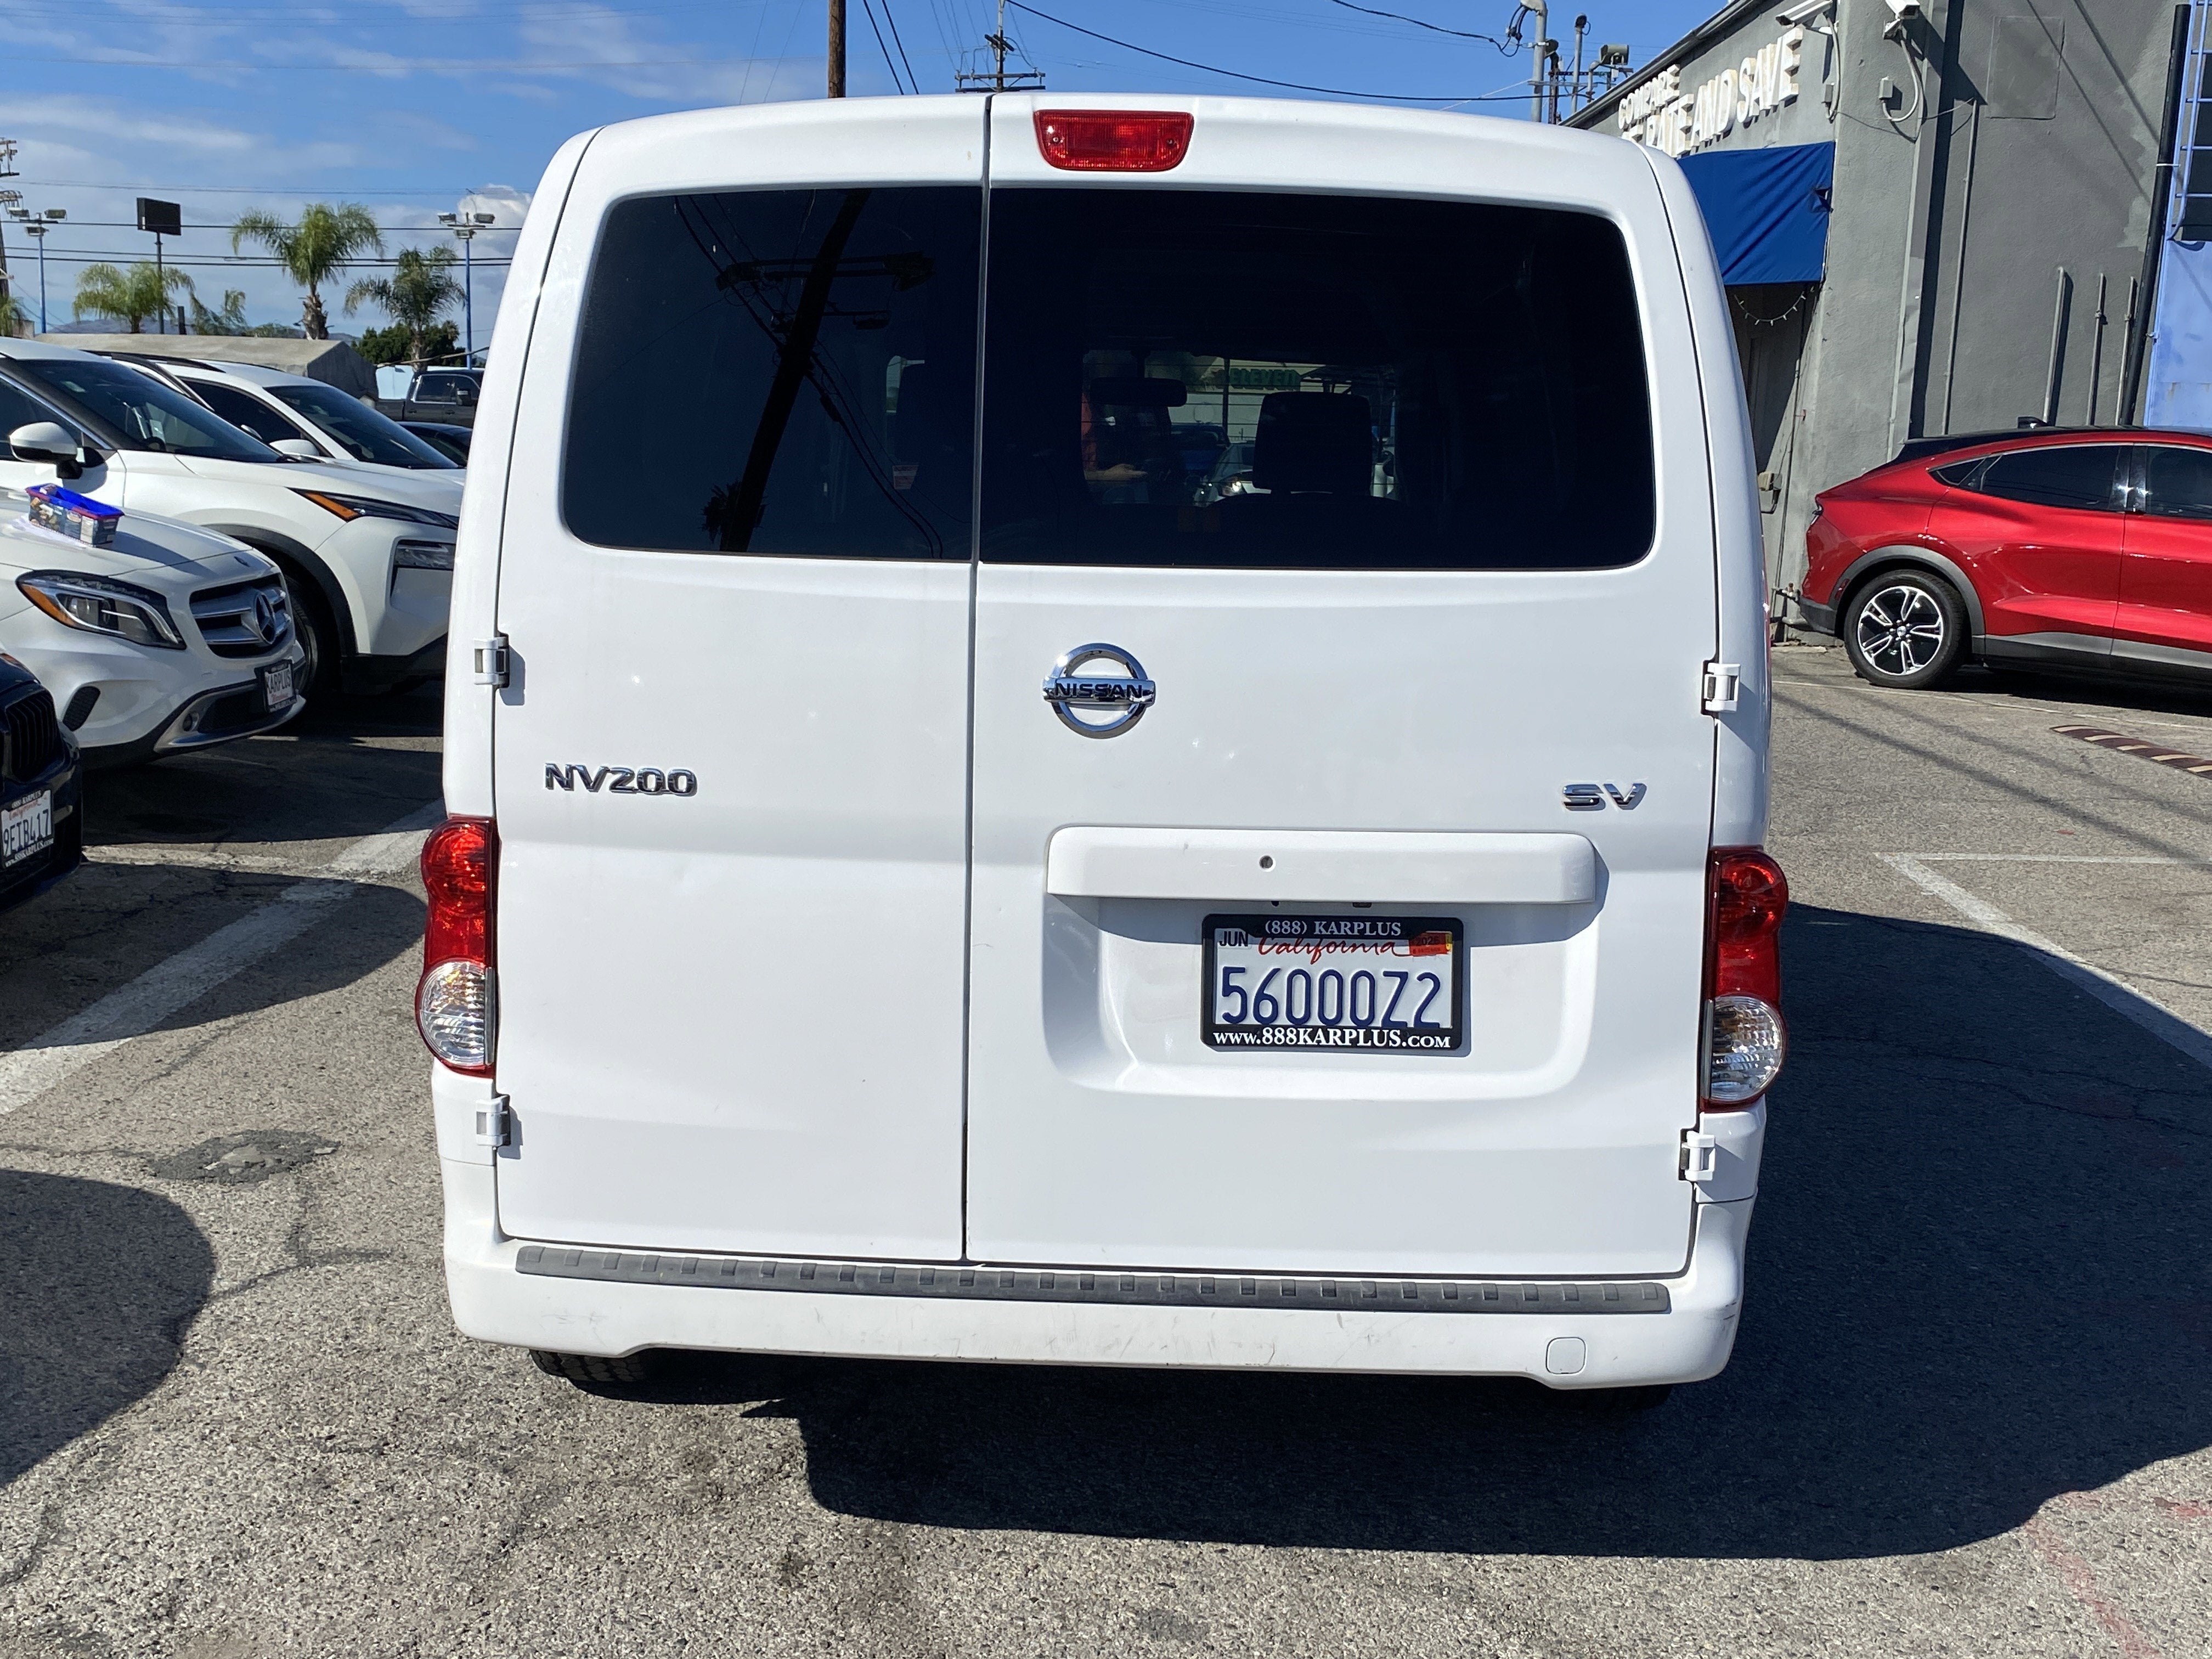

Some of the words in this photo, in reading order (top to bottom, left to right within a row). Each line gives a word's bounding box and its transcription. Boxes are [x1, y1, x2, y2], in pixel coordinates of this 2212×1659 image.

[1690, 69, 1738, 148] AND
[1736, 27, 1804, 123] SAVE
[1054, 682, 1142, 698] NISSAN
[545, 763, 697, 797] NV200
[1562, 782, 1647, 811] SV
[1219, 931, 1249, 947] JUN
[1265, 919, 1308, 935] (888)
[1313, 921, 1402, 936] KARPLUS
[1258, 936, 1404, 965] California
[1221, 966, 1441, 1028] 56000Z2
